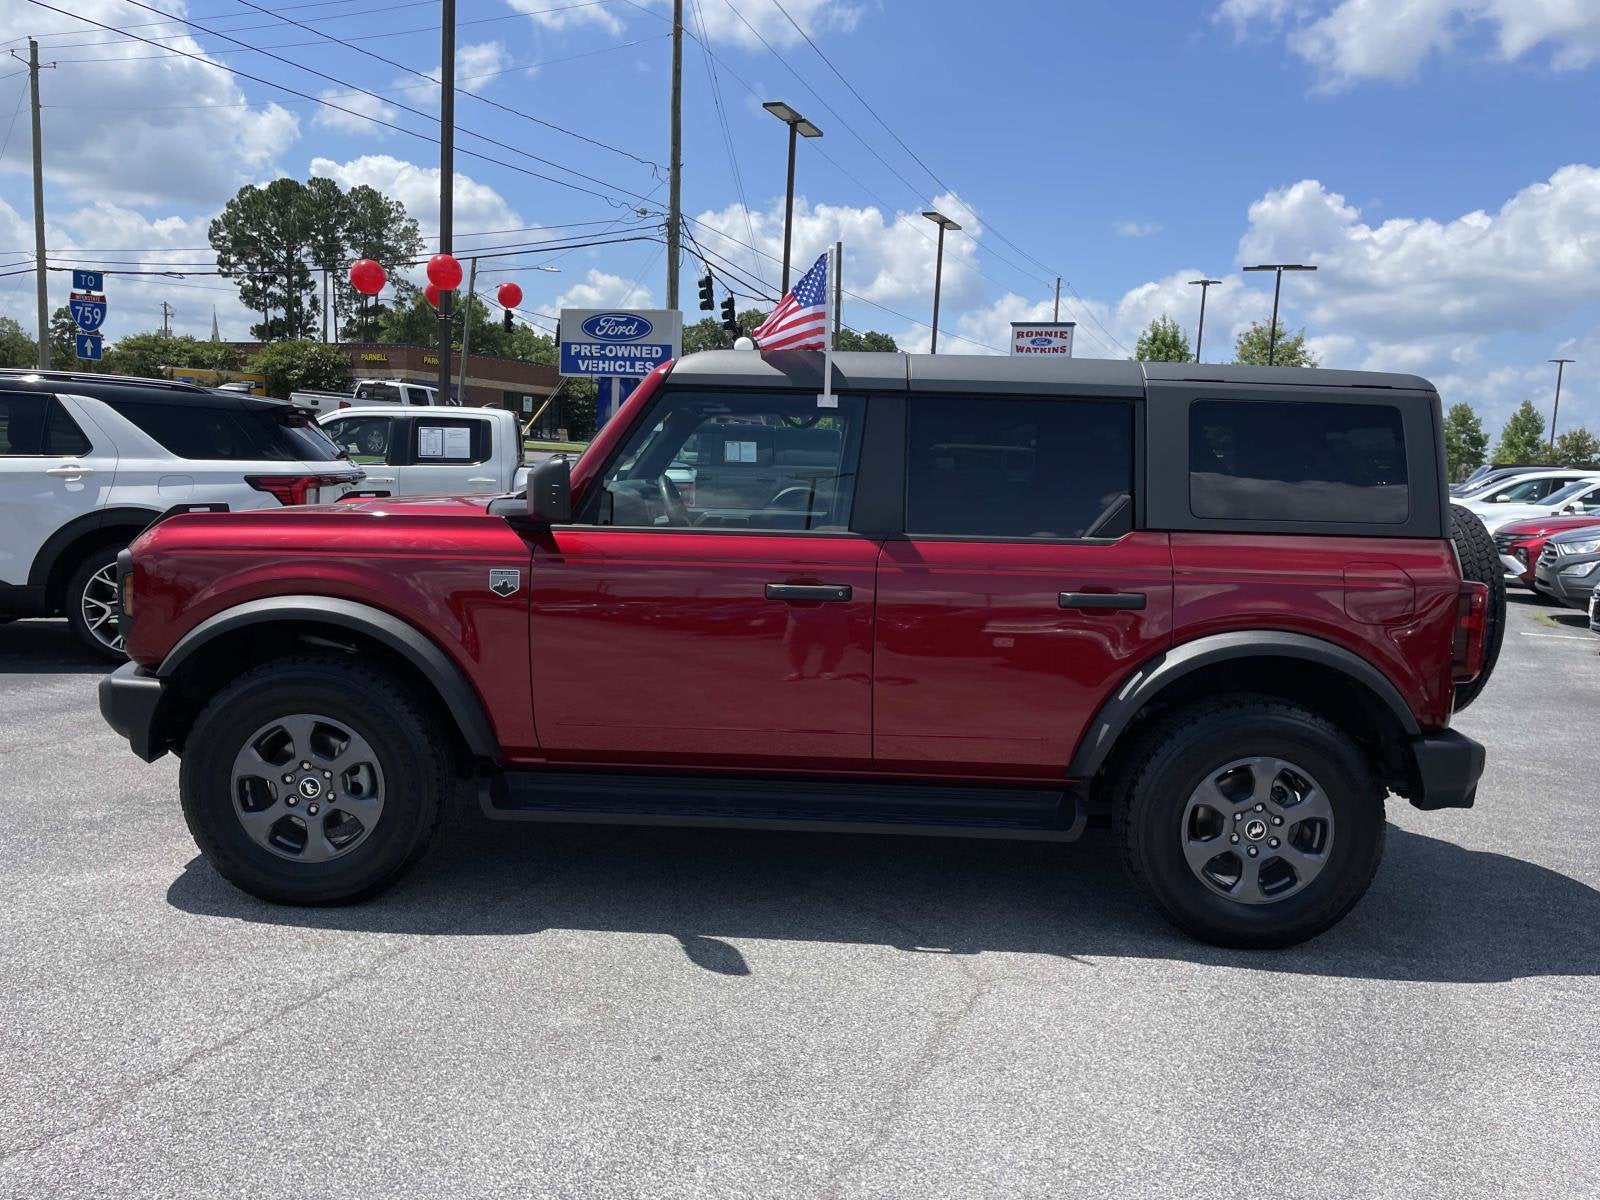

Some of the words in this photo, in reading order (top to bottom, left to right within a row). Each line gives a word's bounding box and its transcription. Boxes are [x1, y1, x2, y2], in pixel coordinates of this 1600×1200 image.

[80, 274, 95, 287] TO
[75, 305, 101, 326] 759
[595, 316, 638, 336] Ford
[1016, 330, 1068, 340] RONNIE
[570, 344, 663, 358] PRE-OWNED
[1015, 345, 1067, 354] WATKINS
[360, 353, 388, 361] PARNELL
[578, 359, 655, 373] VEHICLES
